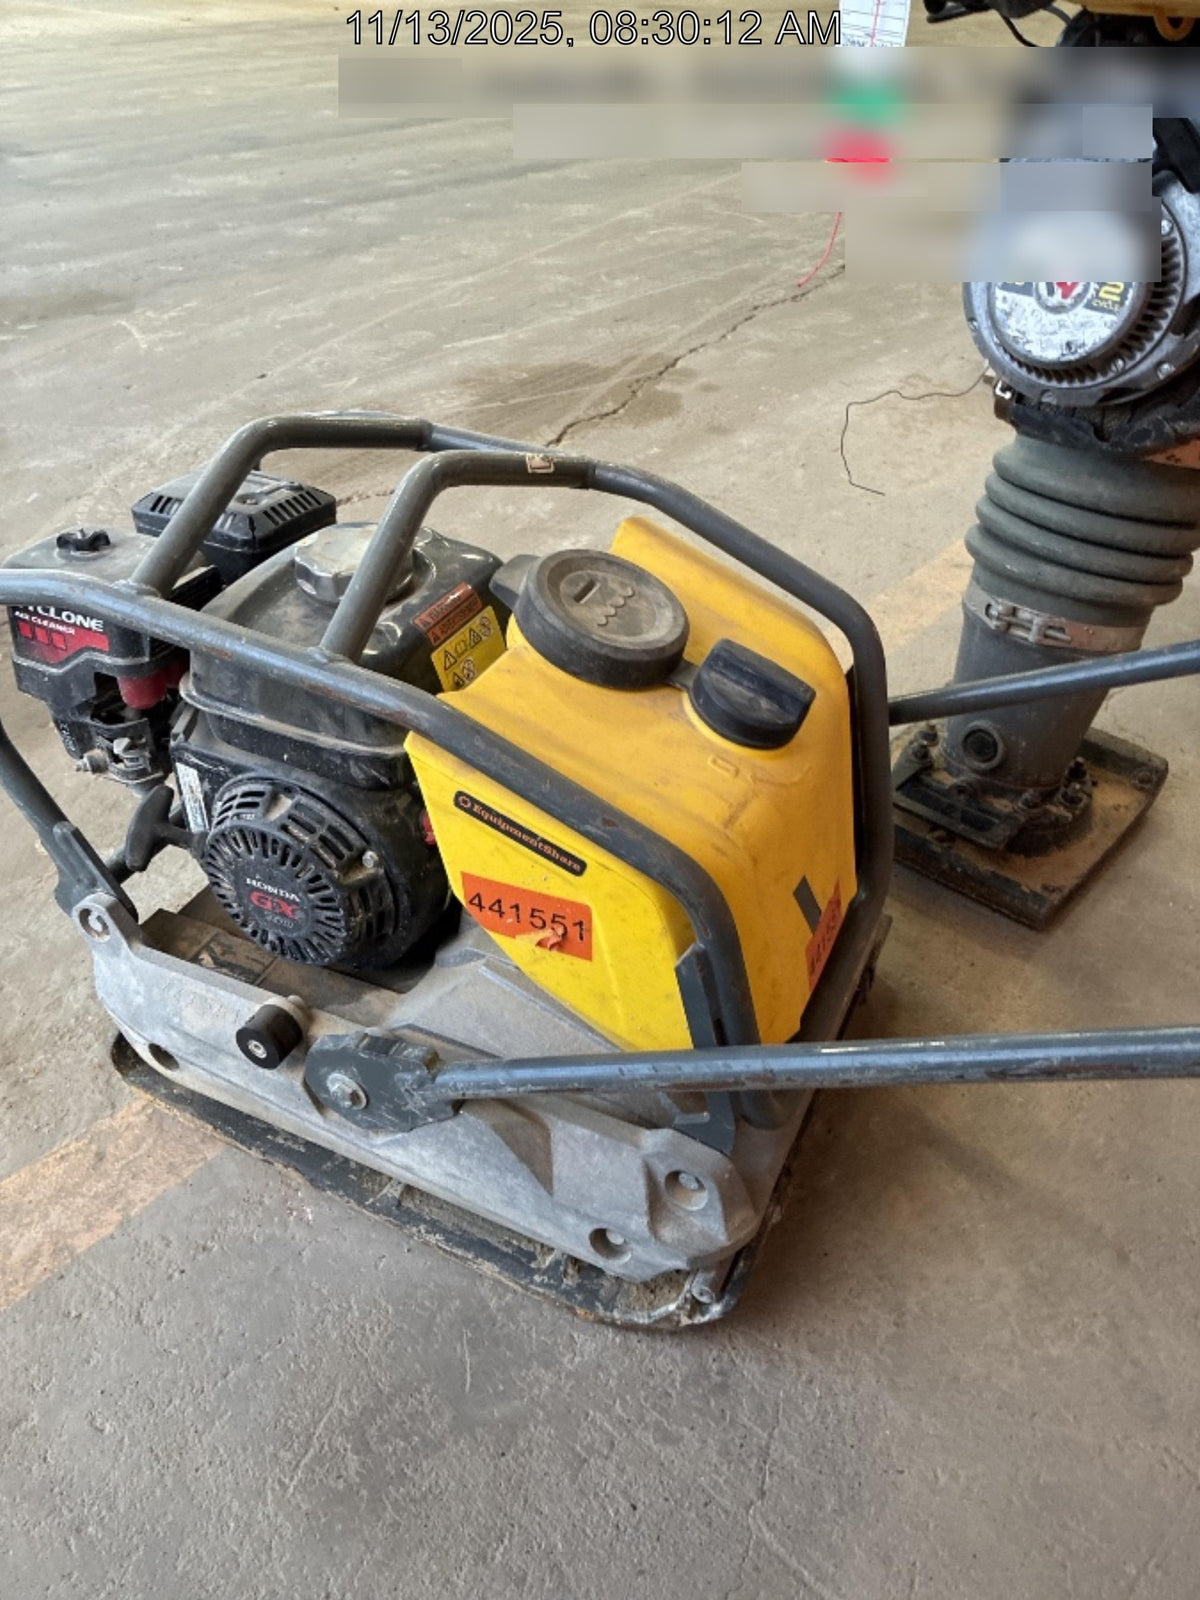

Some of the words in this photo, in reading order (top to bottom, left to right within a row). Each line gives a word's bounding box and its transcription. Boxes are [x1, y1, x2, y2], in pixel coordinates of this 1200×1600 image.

[473, 804, 582, 872] EquipmentShare
[246, 877, 301, 902] HONDA
[250, 890, 300, 919] GX
[468, 892, 585, 942] 441551
